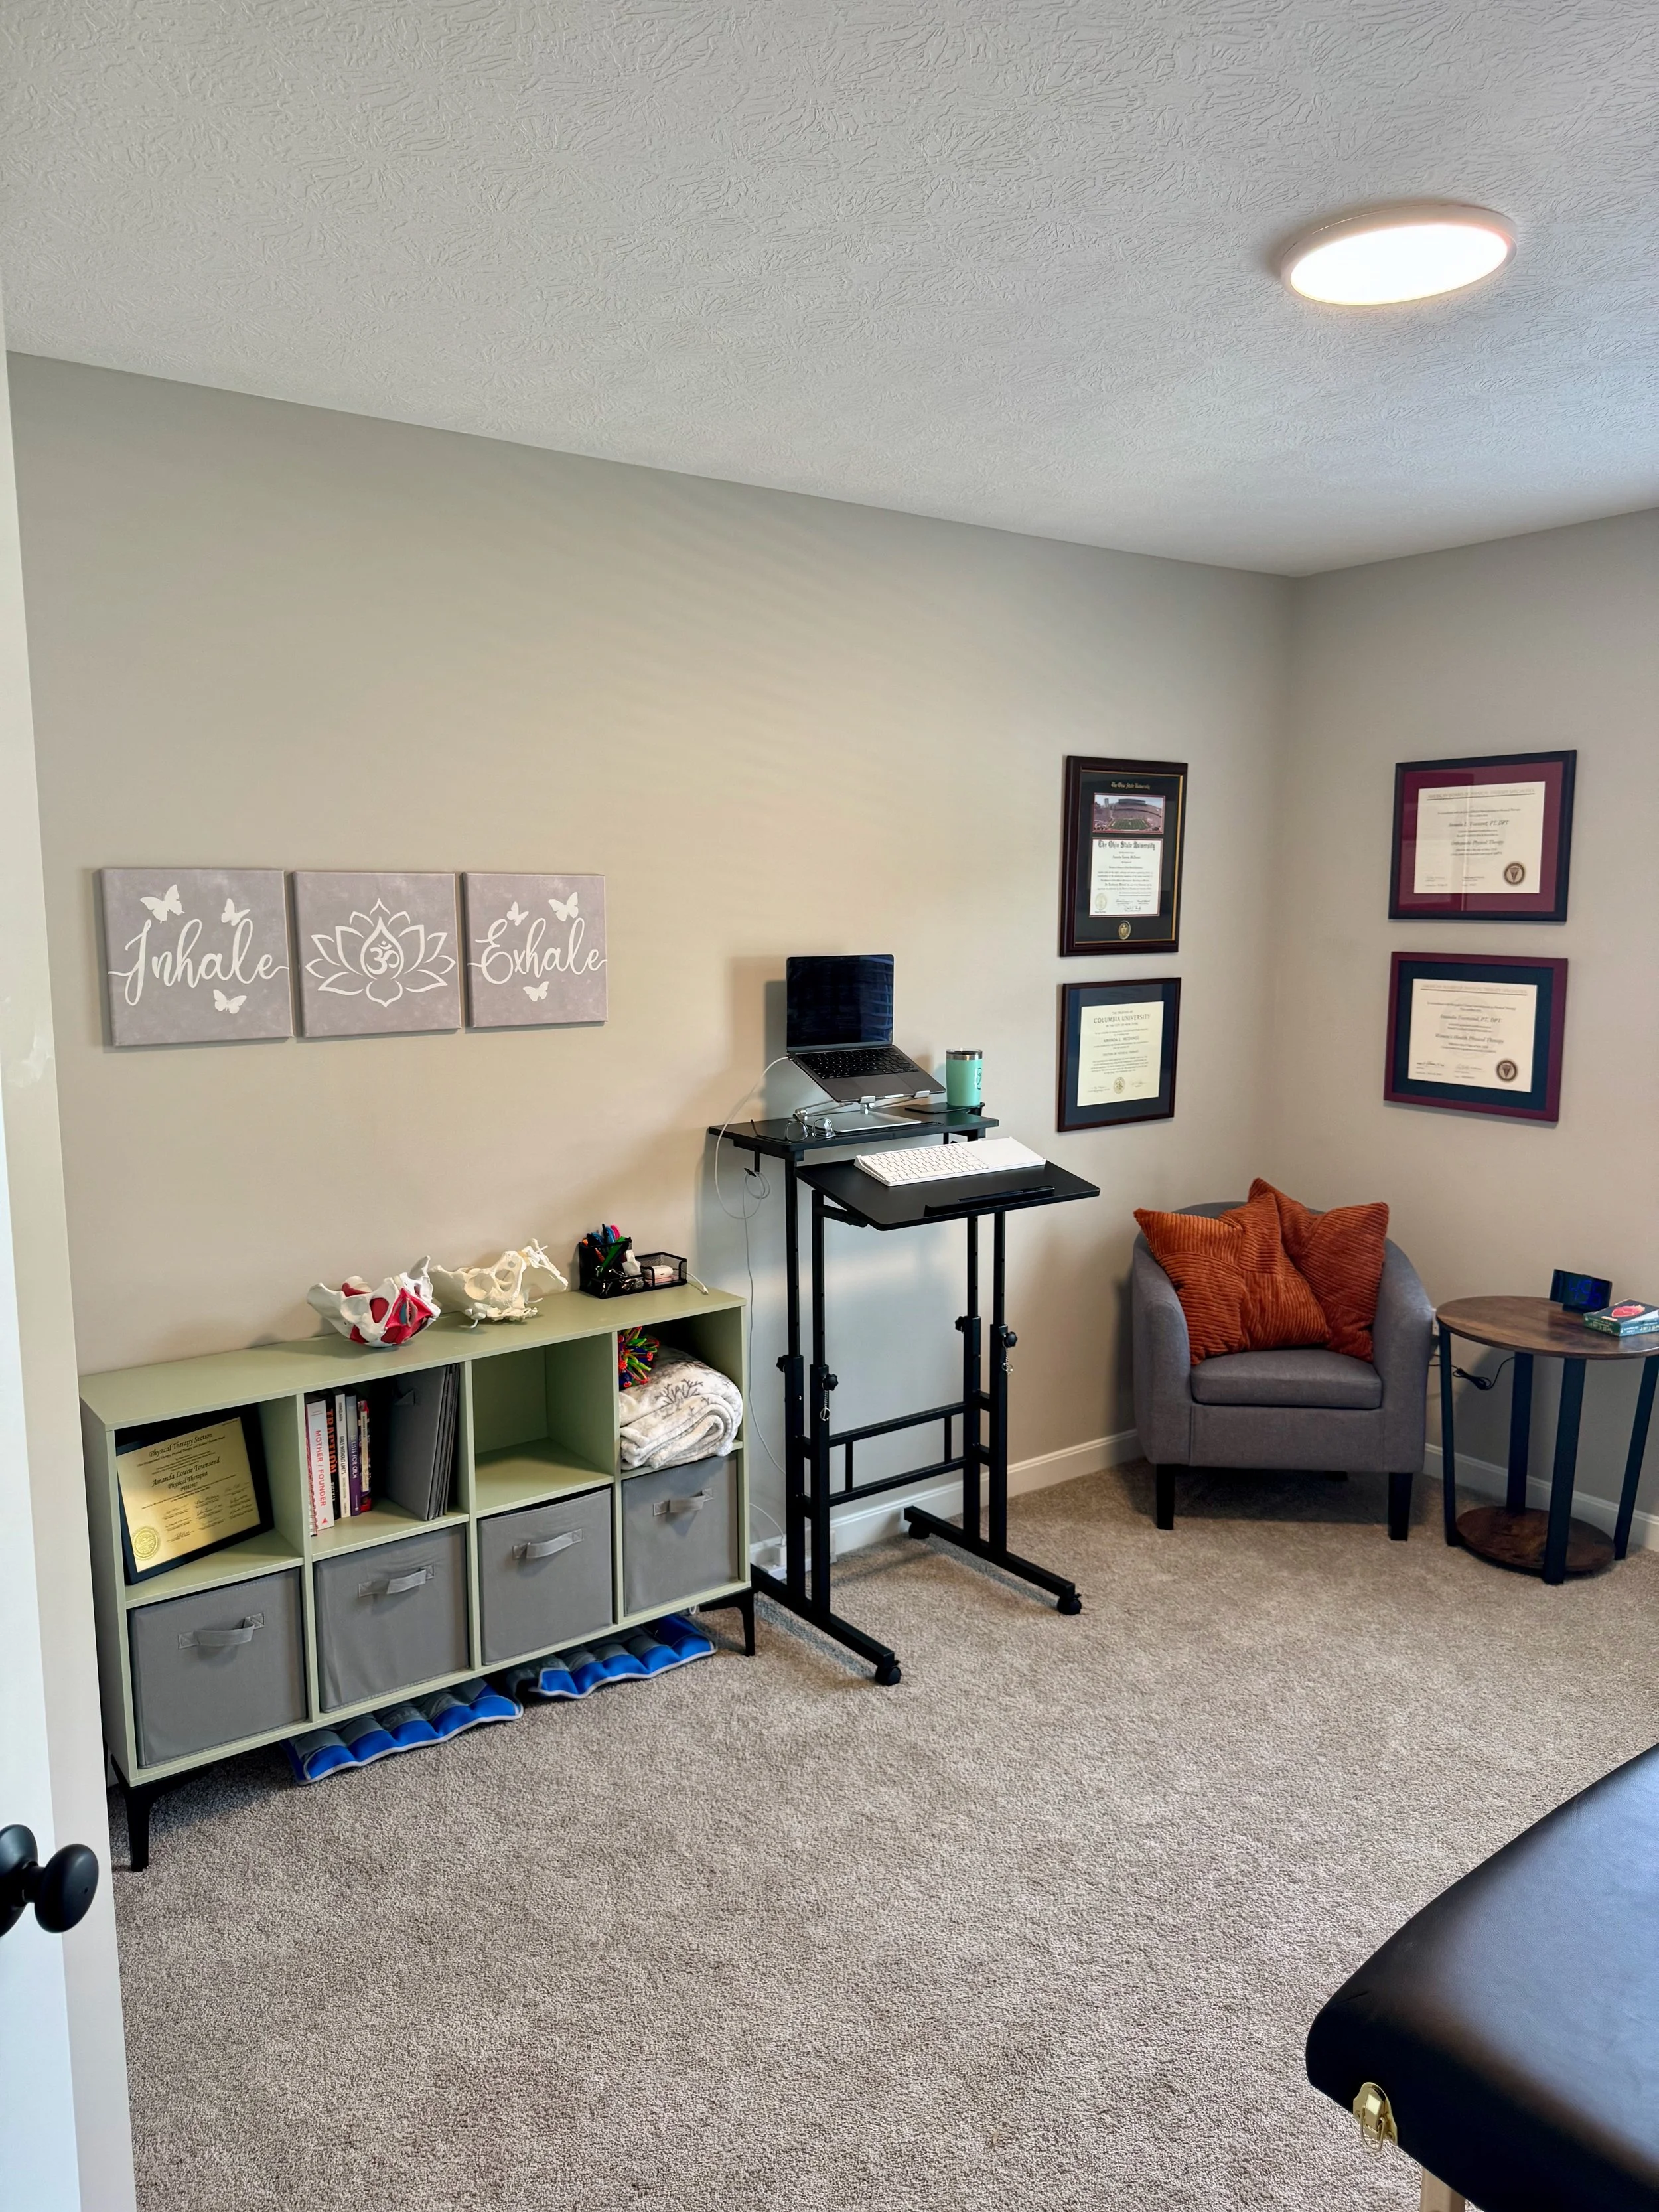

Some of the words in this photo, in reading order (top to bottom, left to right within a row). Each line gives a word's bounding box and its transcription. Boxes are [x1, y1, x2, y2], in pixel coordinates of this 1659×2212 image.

[1098, 840, 1108, 849] The
[1108, 840, 1119, 849] Ohio
[1133, 841, 1155, 851] University
[108, 919, 290, 1006] Inhale
[467, 917, 607, 986] Exhale
[149, 1444, 171, 1457] Physical
[173, 1439, 193, 1449] Therapy
[194, 1434, 213, 1443] Section
[315, 1430, 324, 1463] MOTHER
[326, 1408, 336, 1473] TRACTION
[152, 1473, 175, 1487] Amanda
[176, 1468, 193, 1477] Louise
[194, 1456, 220, 1471] Townsend
[168, 1479, 187, 1489] Physical
[187, 1471, 208, 1482] Therapist
[317, 1469, 327, 1507] FOUNDER
